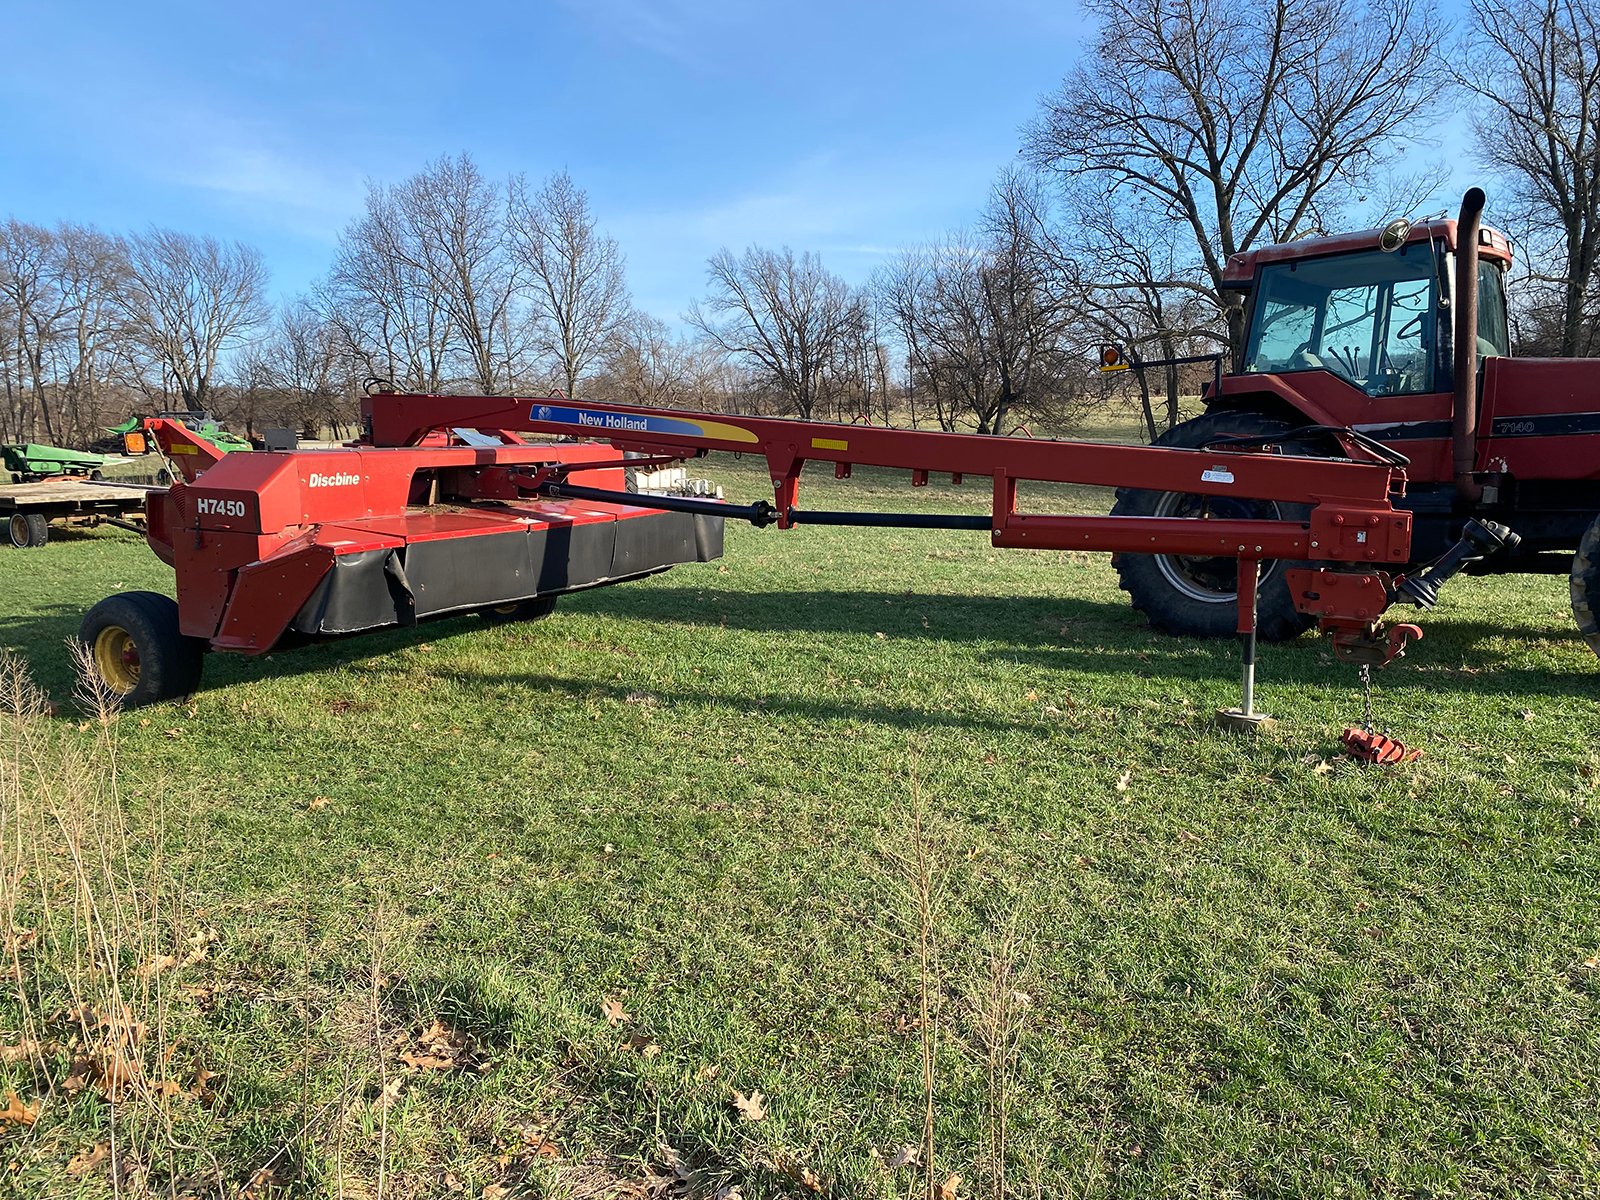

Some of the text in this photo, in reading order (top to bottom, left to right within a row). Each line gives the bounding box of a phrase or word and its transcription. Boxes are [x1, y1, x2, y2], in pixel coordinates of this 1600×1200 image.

[578, 412, 648, 430] New Holland
[1501, 421, 1535, 434] 7140
[308, 472, 360, 488] Discbine
[197, 498, 245, 517] H7450
